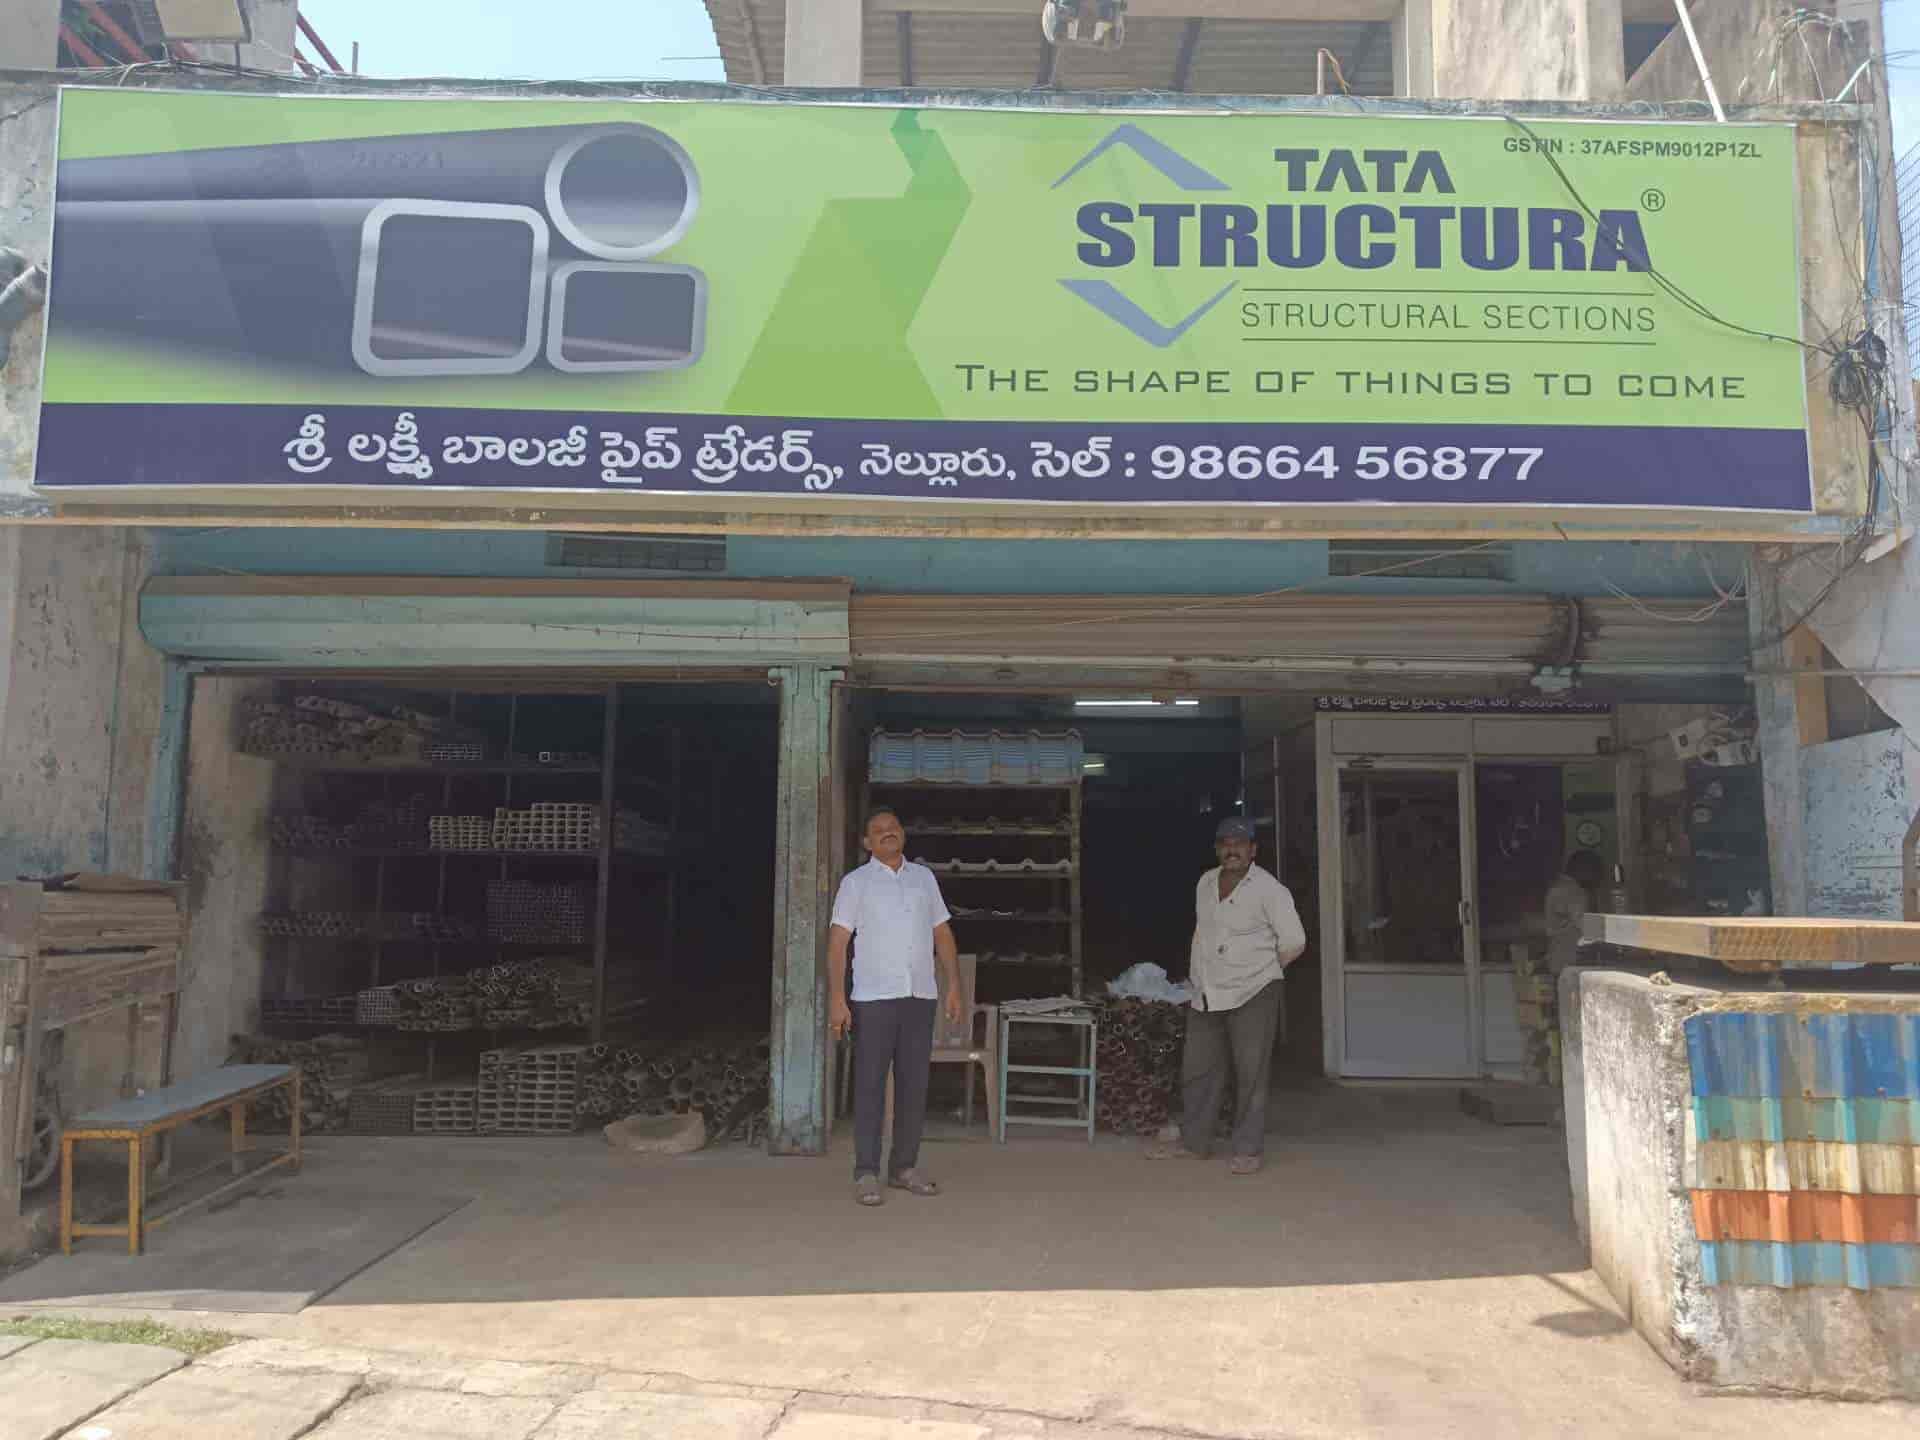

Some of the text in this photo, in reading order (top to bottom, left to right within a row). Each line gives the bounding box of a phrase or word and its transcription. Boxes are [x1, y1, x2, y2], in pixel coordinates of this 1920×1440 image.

[1503, 137, 1563, 153] GSTIN
[1581, 139, 1763, 158] 37AFSPM9012P1ZL
[1274, 148, 1456, 194] TATA
[1076, 202, 1652, 273] STRUCTURA
[1241, 302, 1656, 332] STRUCTURAL SECTIONS
[1074, 369, 1231, 394] SHAPE
[1255, 370, 1315, 394] OF
[1336, 371, 1511, 396] THINGS
[1534, 373, 1592, 397] TO
[1618, 375, 1745, 399] COME
[283, 413, 333, 473] శ్రీ
[442, 425, 588, 466] బాలజీ
[599, 427, 682, 483] పైప్
[1030, 435, 1113, 478] సెల్
[1151, 445, 1340, 480] 98664
[1354, 446, 1544, 481] 56877
